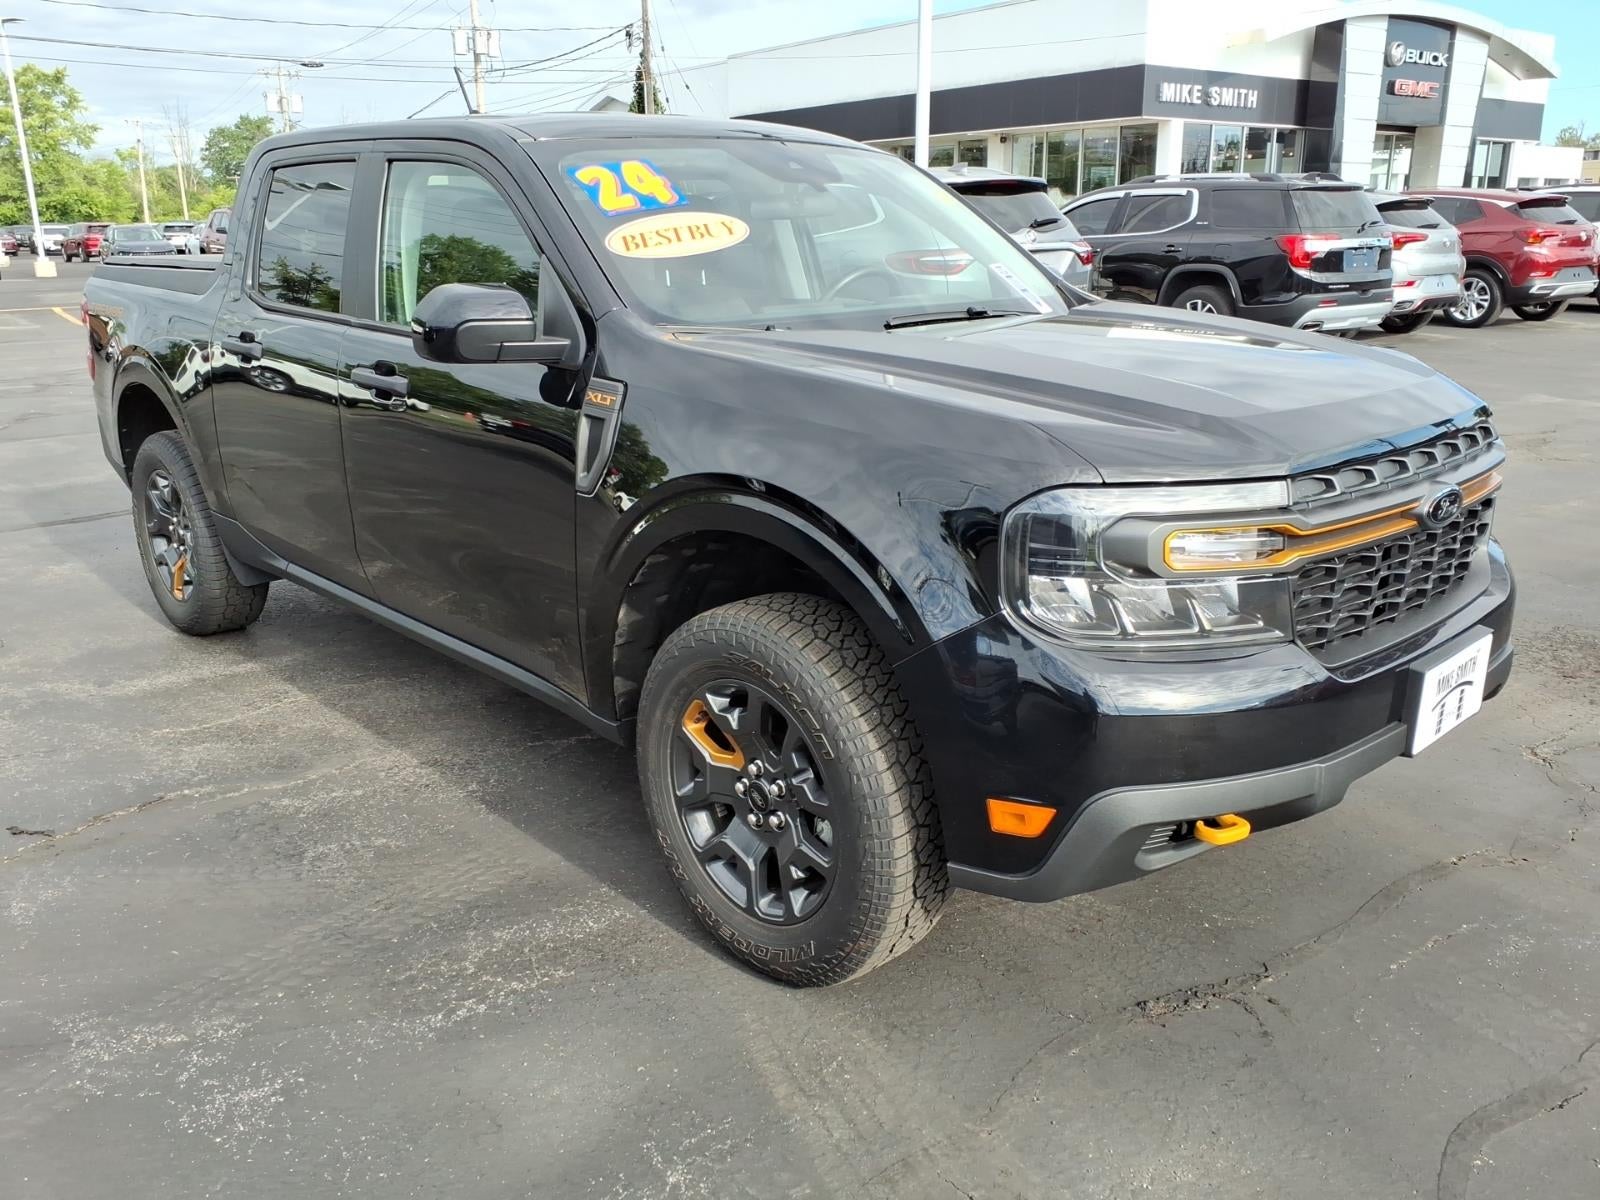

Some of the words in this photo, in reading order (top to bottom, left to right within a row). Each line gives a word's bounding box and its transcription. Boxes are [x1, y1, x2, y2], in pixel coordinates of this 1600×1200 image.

[1405, 48, 1449, 67] BUICK
[1160, 82, 1202, 104] MIKE
[1208, 86, 1258, 109] SMITH
[1394, 79, 1440, 98] GMC
[575, 160, 679, 213] 24
[586, 391, 616, 406] XLT
[1437, 669, 1455, 696] MIKE
